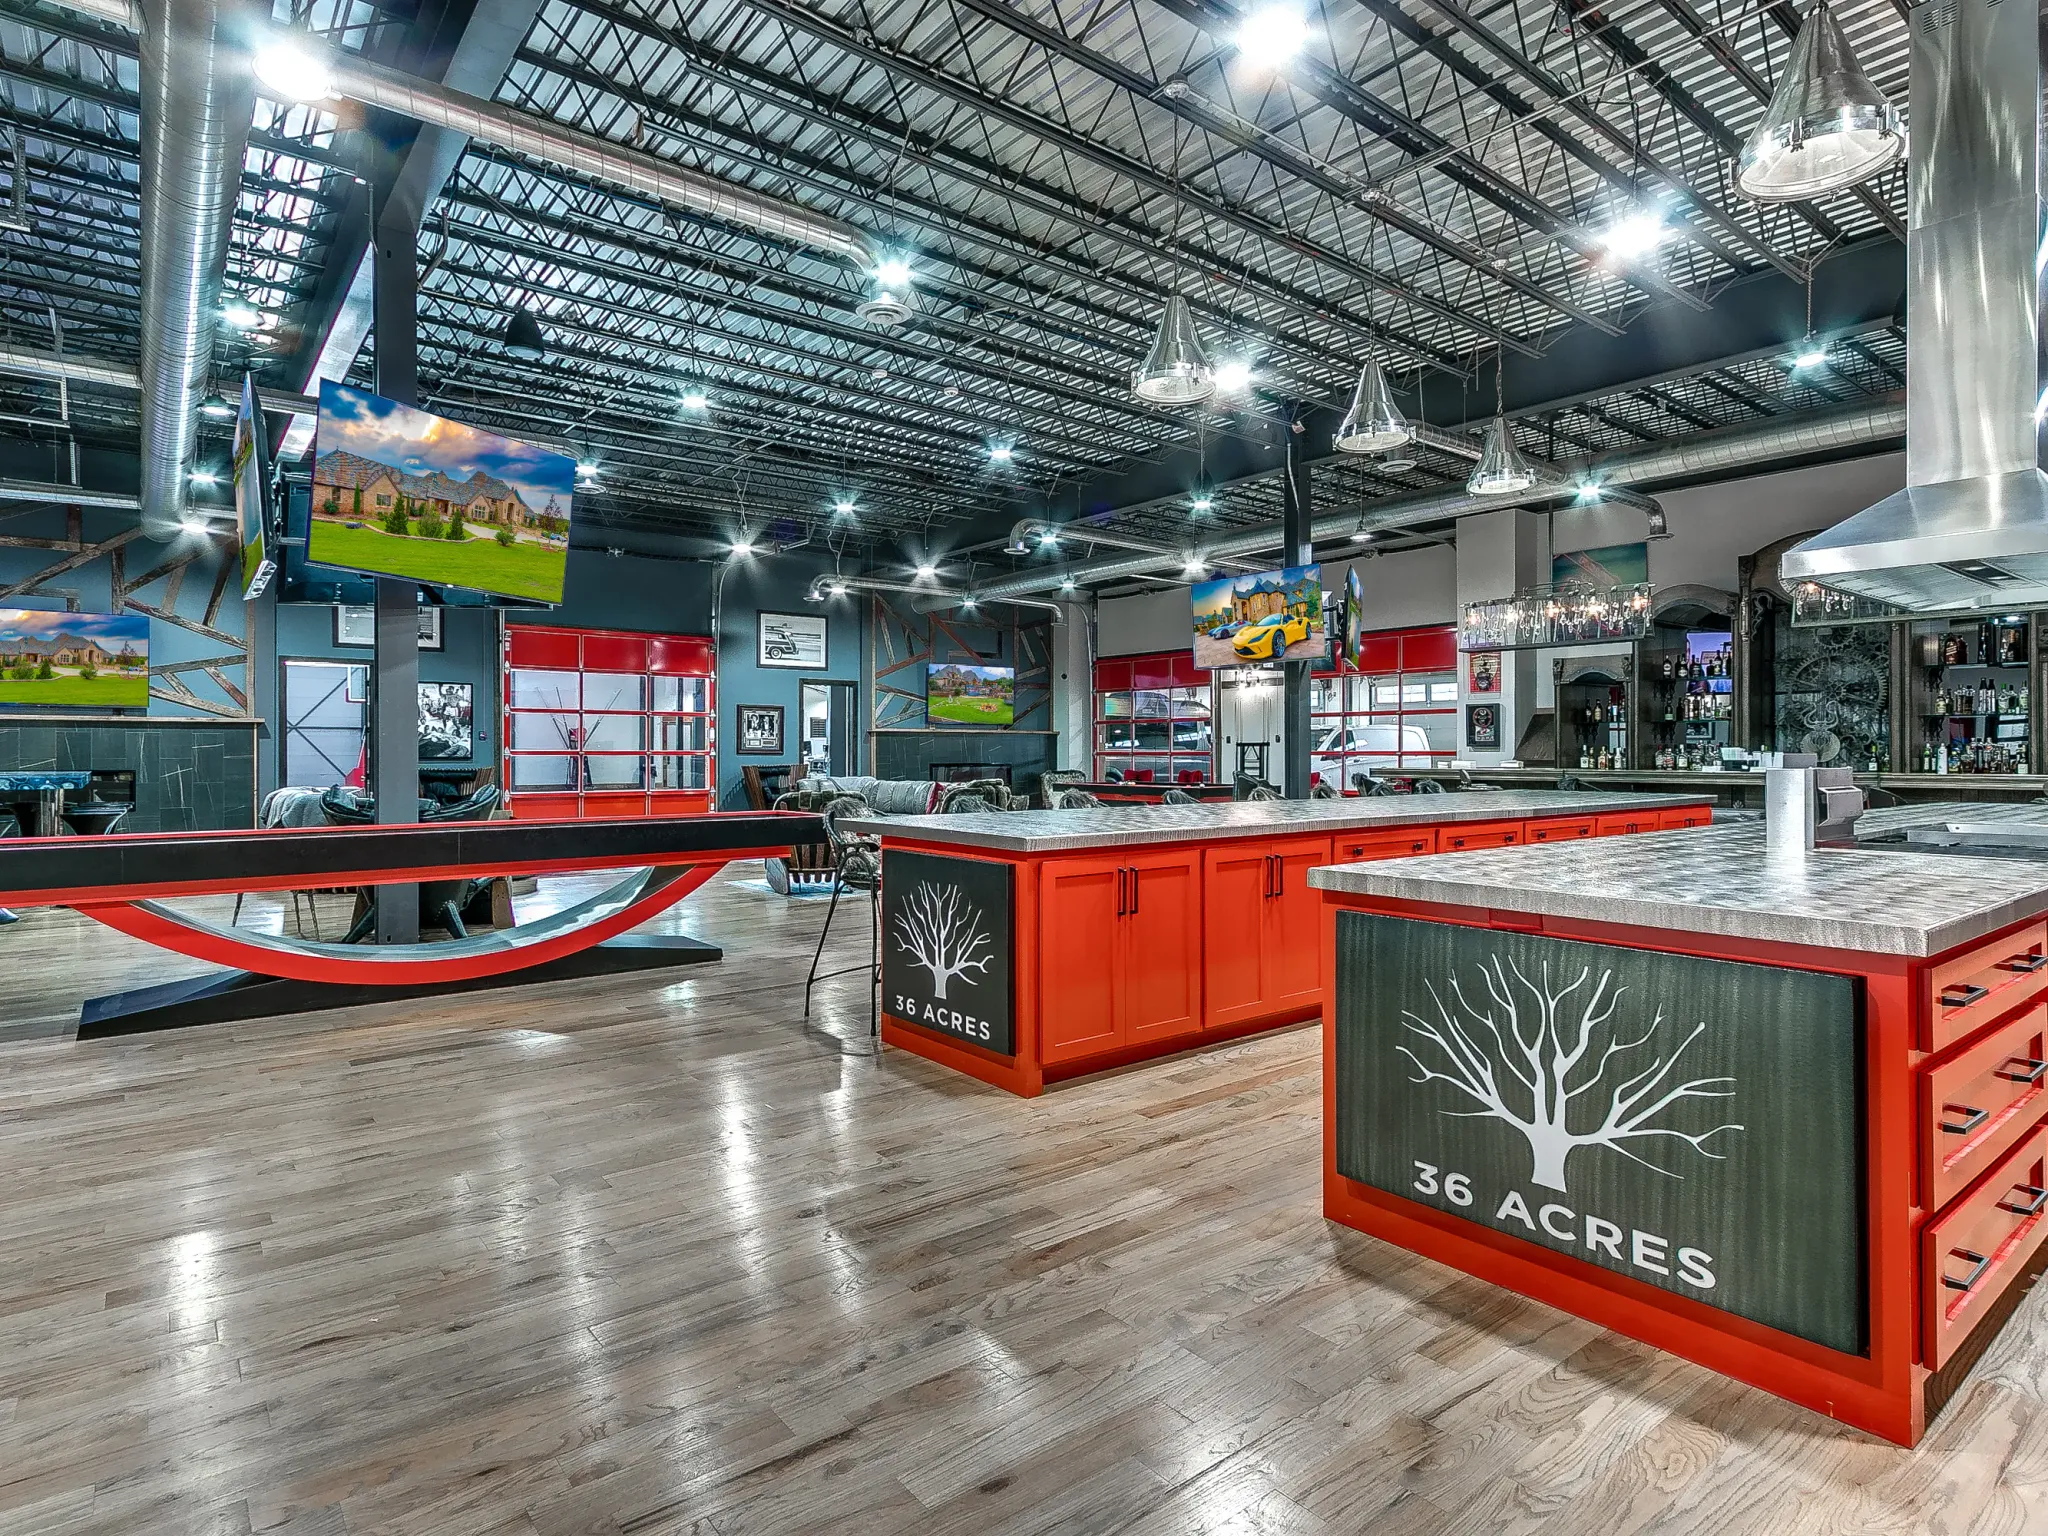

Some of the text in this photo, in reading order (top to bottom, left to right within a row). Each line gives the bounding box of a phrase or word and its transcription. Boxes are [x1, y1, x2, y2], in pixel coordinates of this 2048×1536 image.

[895, 994, 991, 1040] 36 ACRES
[1412, 1160, 1717, 1289] 36 ACRES
